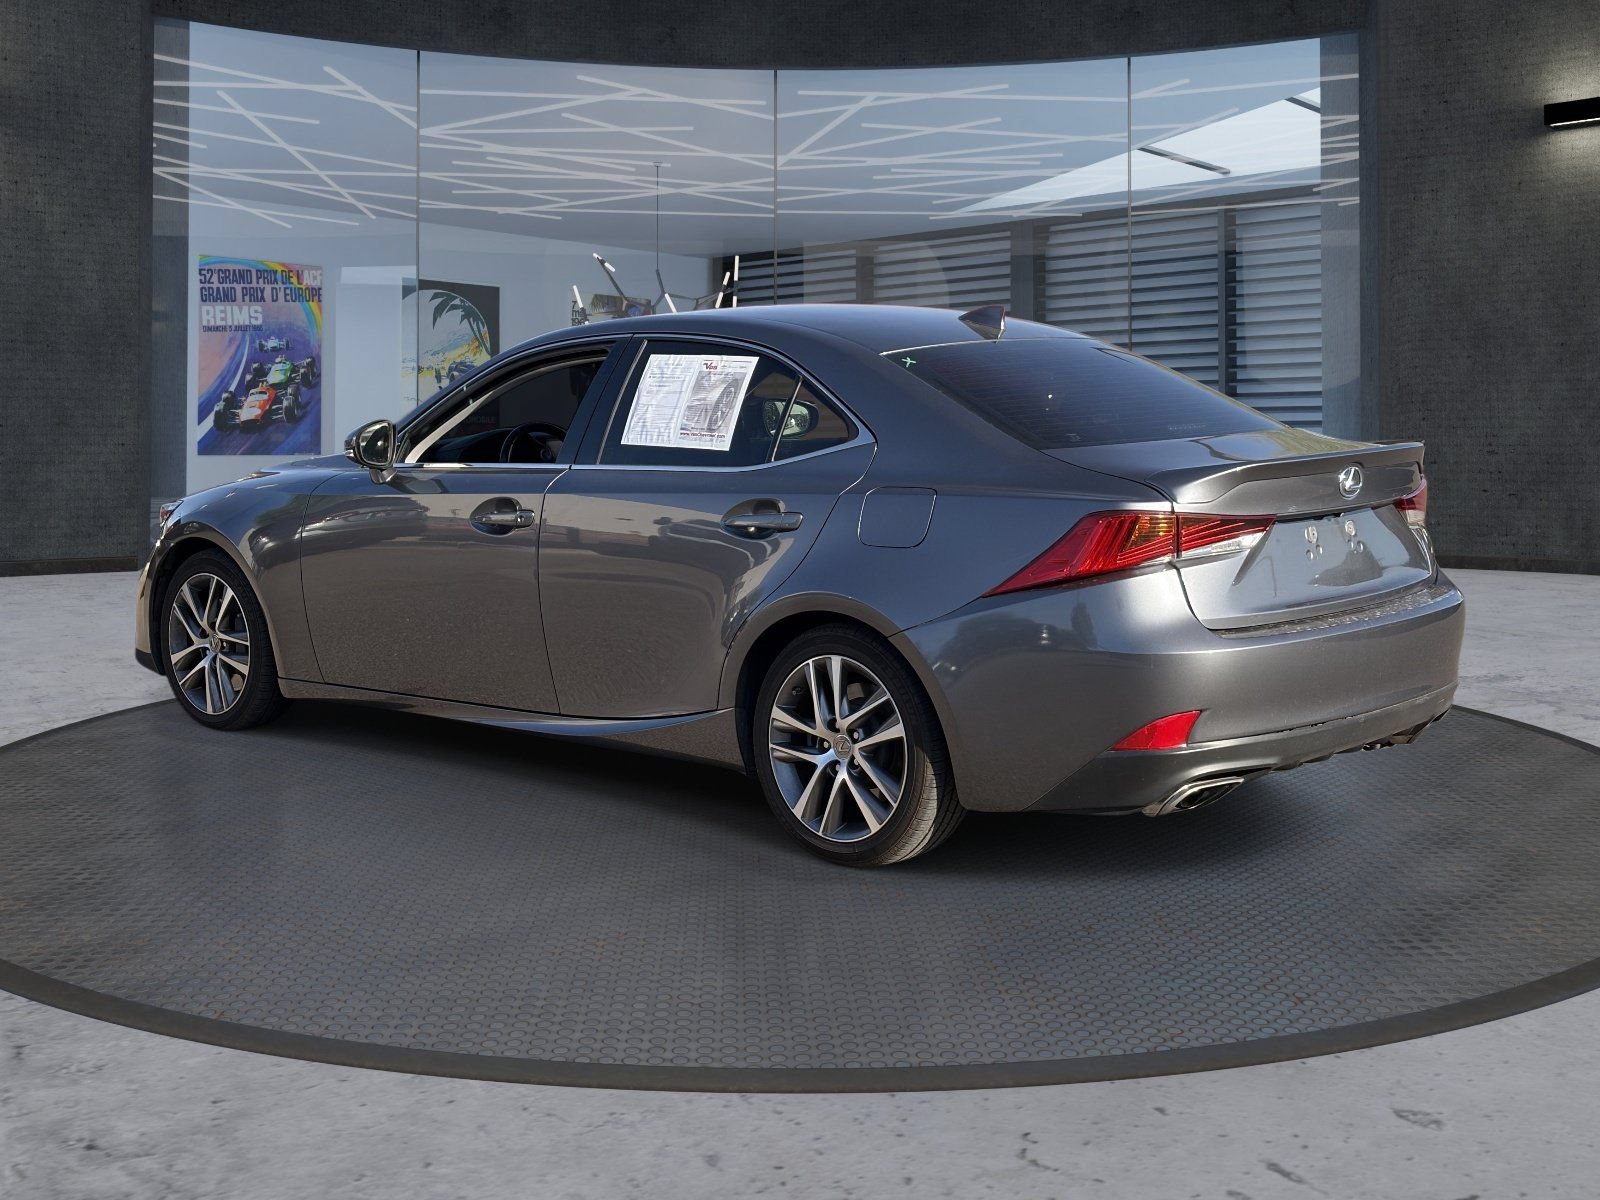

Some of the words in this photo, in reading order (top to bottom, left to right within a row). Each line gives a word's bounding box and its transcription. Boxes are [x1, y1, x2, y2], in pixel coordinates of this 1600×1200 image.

[217, 269, 253, 285] GRAND
[256, 269, 279, 286] PRIX
[281, 269, 294, 286] DE
[200, 286, 237, 303] GRAND
[242, 286, 266, 303] PRIX
[201, 305, 263, 325] REIMS
[202, 325, 228, 333] DIMANCHE
